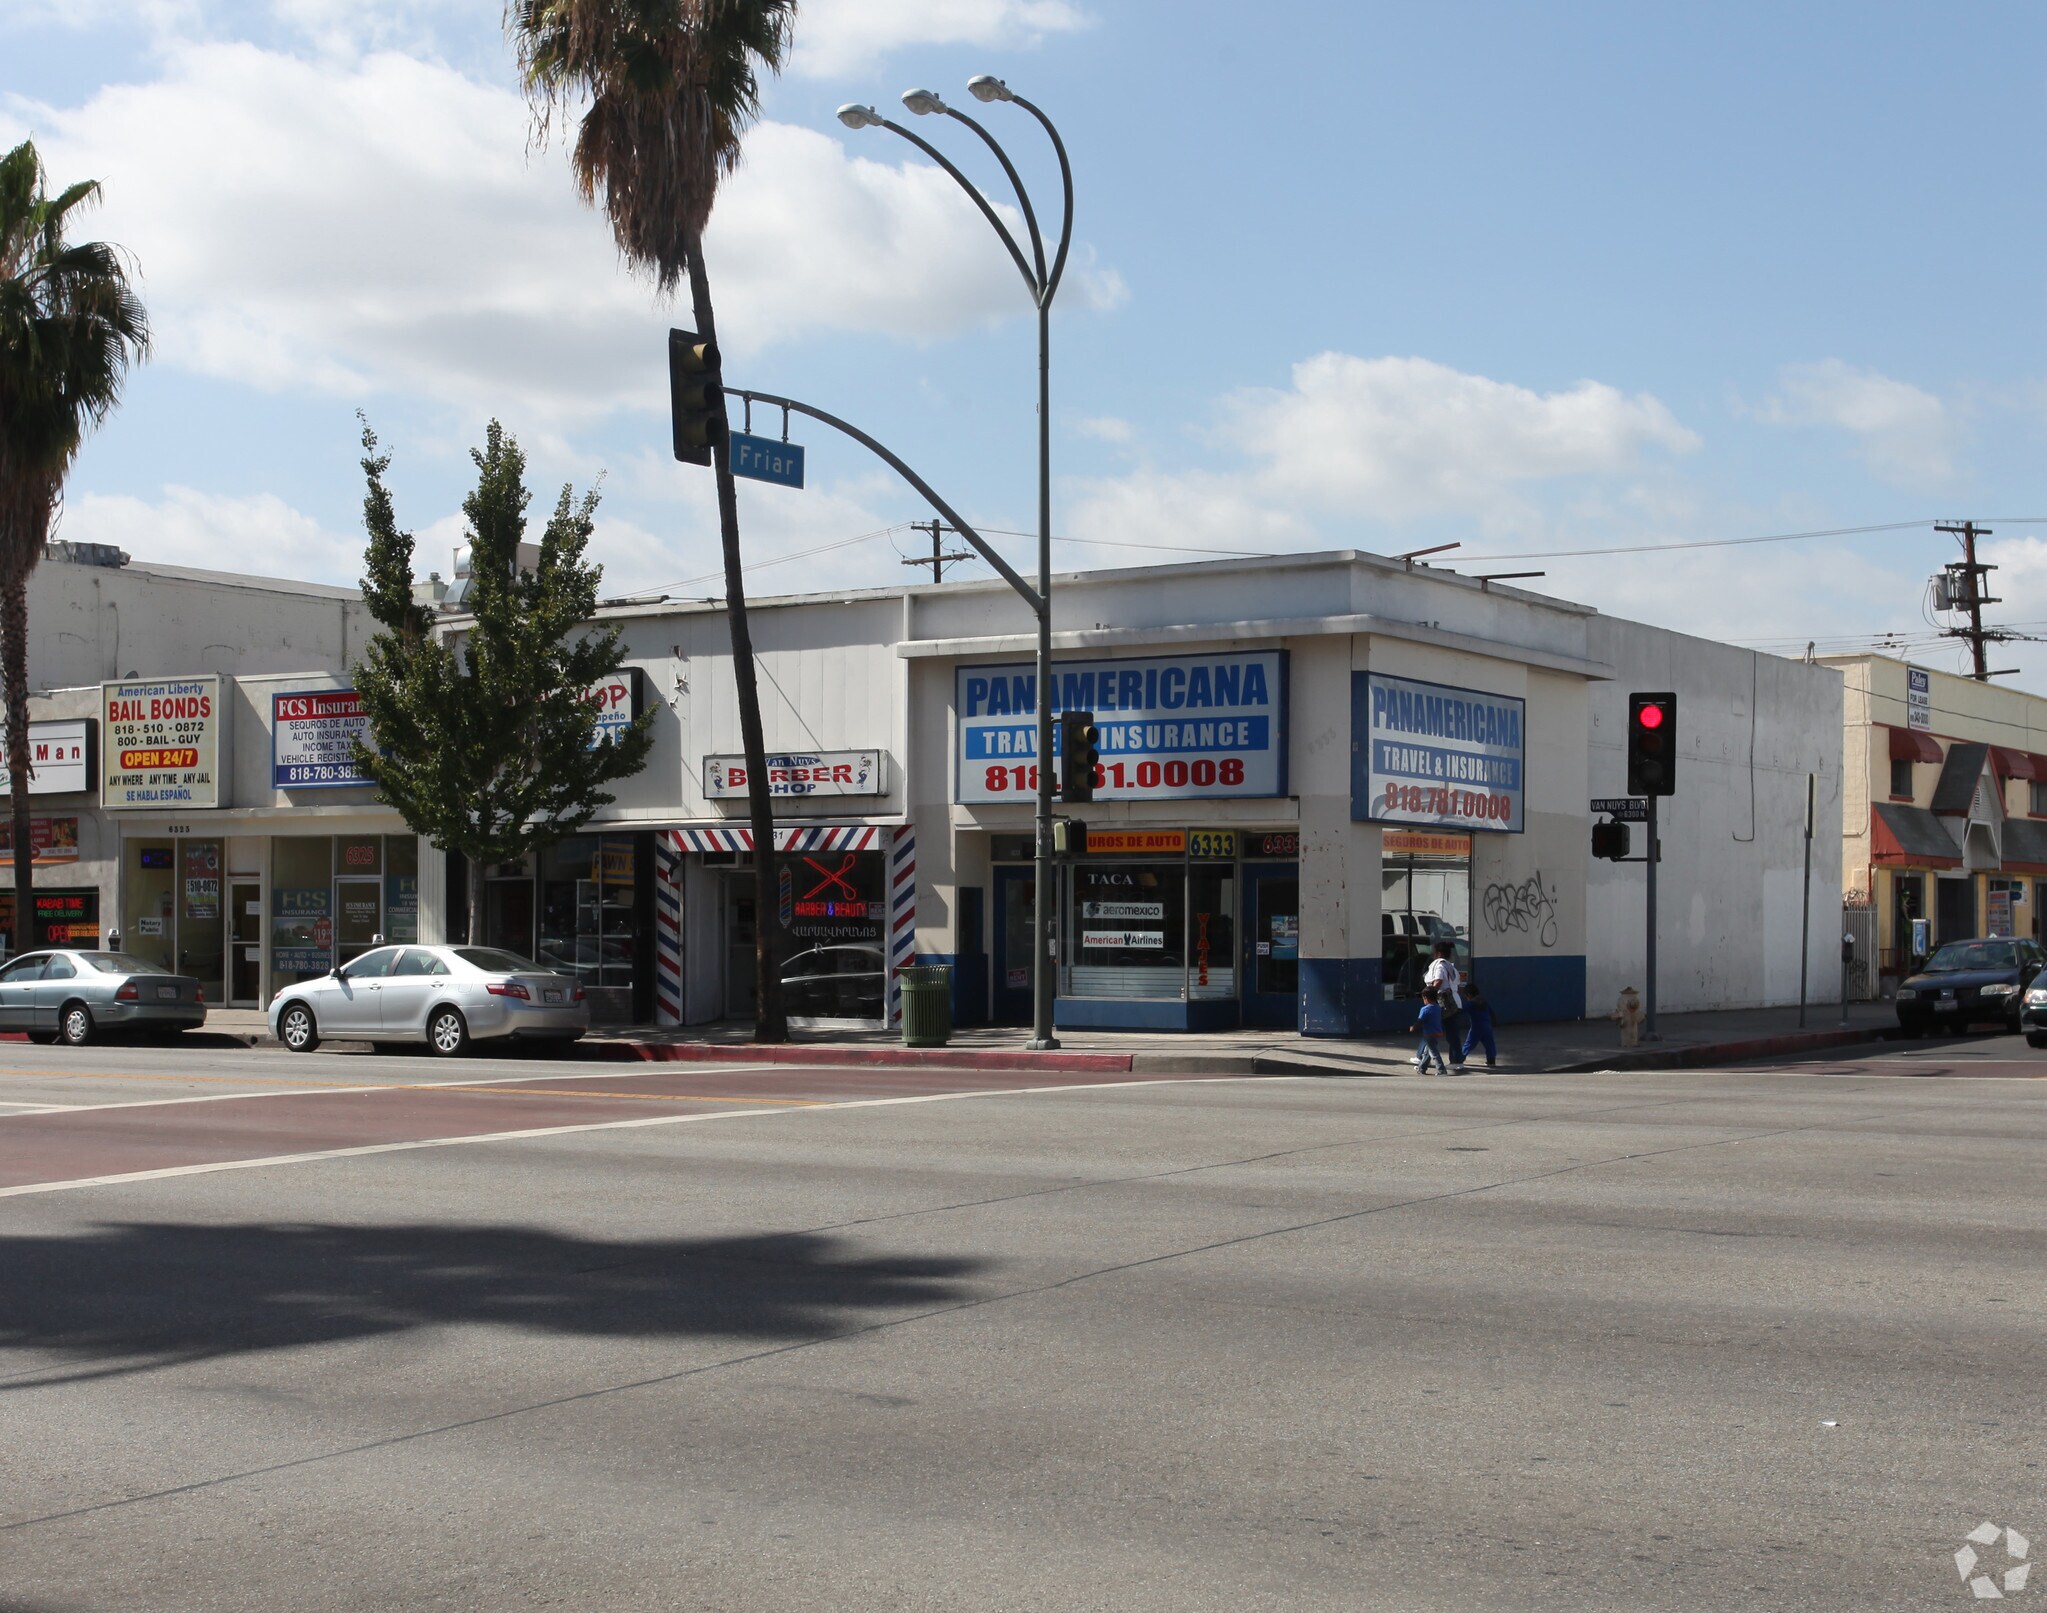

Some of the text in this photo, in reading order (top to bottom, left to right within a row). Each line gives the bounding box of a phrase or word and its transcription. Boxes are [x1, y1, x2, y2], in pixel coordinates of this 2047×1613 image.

[740, 444, 794, 476] Friar
[117, 683, 204, 697] American Liberty
[109, 696, 211, 722] BAIL BONDS
[278, 698, 365, 717] FCS Insuran
[330, 719, 341, 729] DE
[344, 717, 366, 728] AUTO
[1373, 686, 1519, 749] PANAMERICANA
[292, 731, 315, 742] AUTO
[983, 721, 1249, 754] TRAV INSURANCE
[302, 741, 333, 752] INCOME
[125, 750, 193, 767] OPEN 24/7
[281, 753, 354, 764] VEHICLE REGISTR
[789, 756, 817, 767] Nuys
[1383, 745, 1513, 785] TRAVEL & INSURANCE
[109, 772, 210, 786] ANY WHERE ANY TIME ANY JAIL
[289, 765, 363, 781] 818-780-382
[728, 764, 853, 788] BRBER
[985, 758, 1245, 791] 81.1.0008
[126, 785, 192, 801] SE HABLA ESPAÑOL
[1385, 782, 1511, 821] 818.781.0008
[1591, 800, 1606, 810] VAN
[1606, 800, 1627, 810] NUYS
[1088, 834, 1181, 848] UROS DE AUTO
[1190, 834, 1234, 855] 6333
[1383, 836, 1469, 850] SEGUROS DE AUTO
[345, 846, 375, 865] 6325
[1087, 873, 1133, 885] TACA
[65, 897, 84, 909] TIME
[282, 891, 327, 908] FCS
[37, 909, 84, 918] FREE DELIVERY
[795, 901, 868, 917] BARBER & BEAUTY
[1102, 905, 1160, 917] aeromexico
[140, 919, 161, 928] Notary
[1084, 934, 1163, 945] American Airlines
